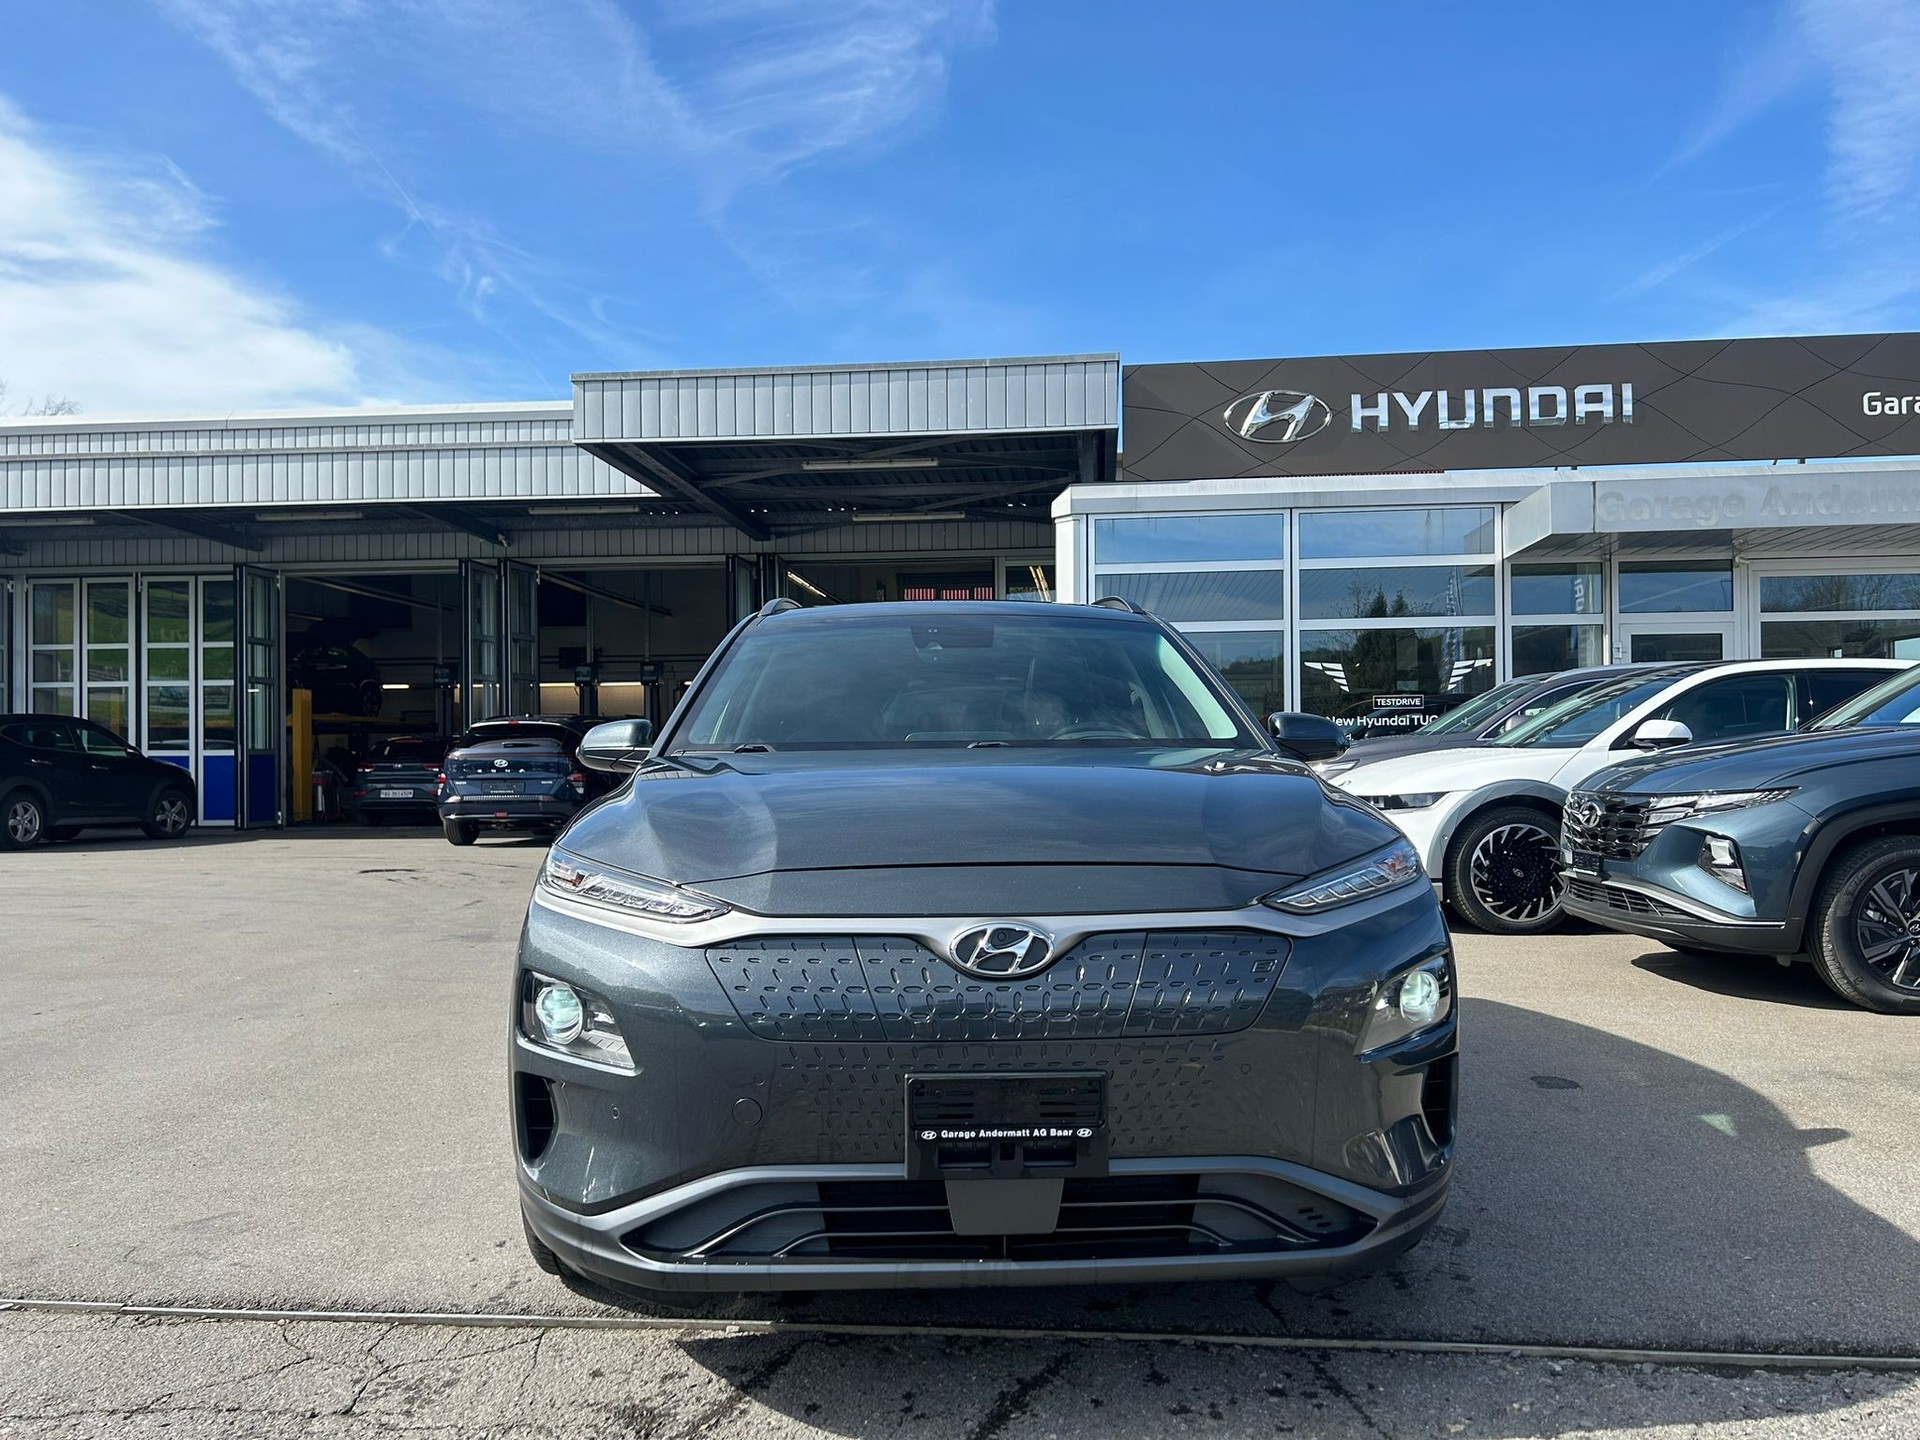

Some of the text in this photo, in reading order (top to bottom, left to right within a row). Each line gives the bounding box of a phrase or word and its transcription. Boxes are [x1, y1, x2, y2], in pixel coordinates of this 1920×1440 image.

[1351, 383, 1633, 433] HYUNDAI
[1598, 491, 1746, 528] Garage
[1376, 698, 1421, 706] TESTDRIVE
[1357, 715, 1410, 728] Hyundai
[941, 1128, 1073, 1139] Garage Andermatt AG Baar
